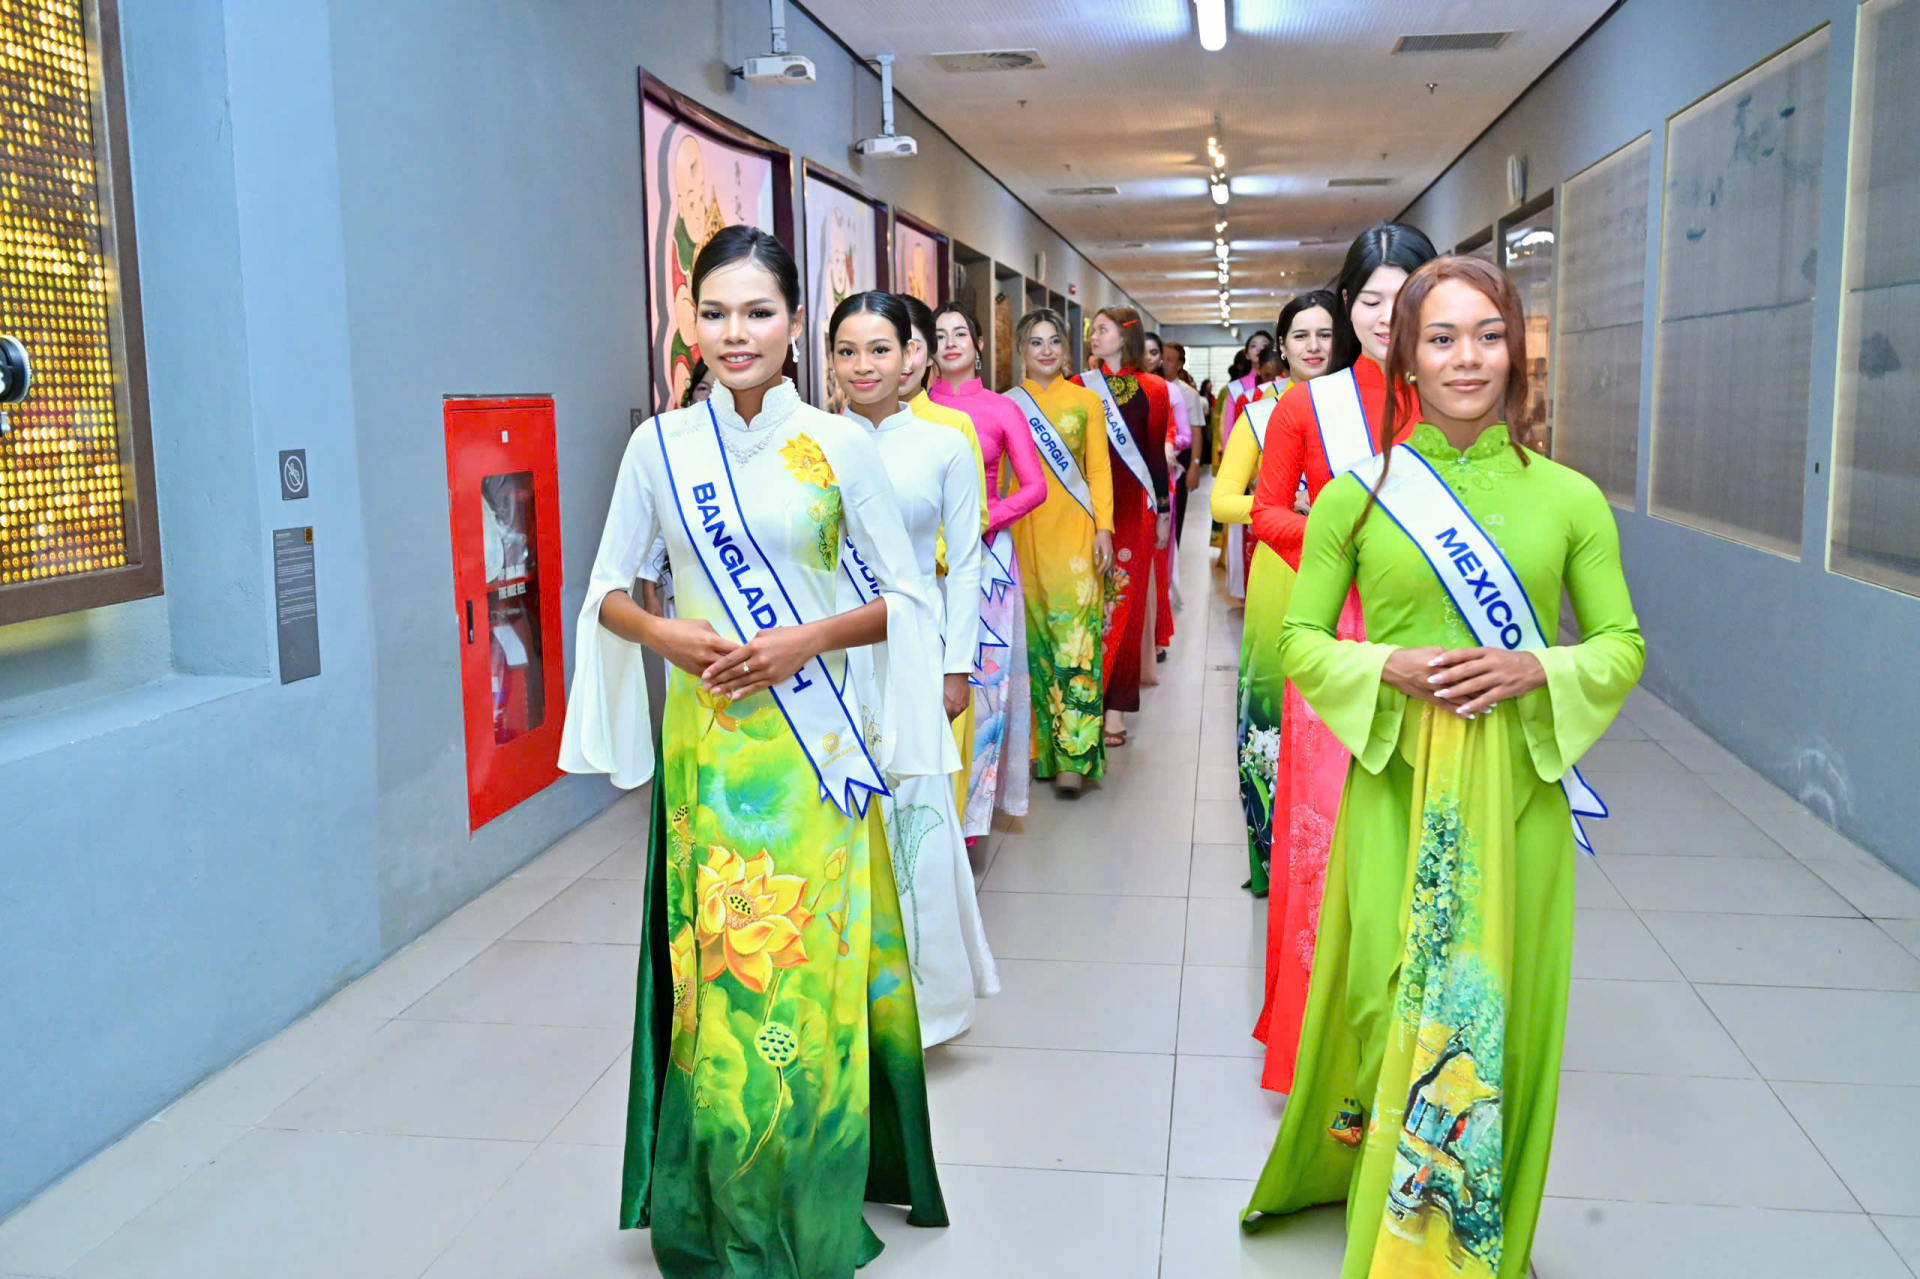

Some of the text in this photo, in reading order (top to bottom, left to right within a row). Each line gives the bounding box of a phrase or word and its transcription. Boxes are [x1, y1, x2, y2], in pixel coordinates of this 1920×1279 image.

[1029, 417, 1069, 472] GEORGIA
[1101, 399, 1127, 446] FINLAND
[693, 481, 813, 694] BANGLADH
[1435, 527, 1522, 650] MEXICO
